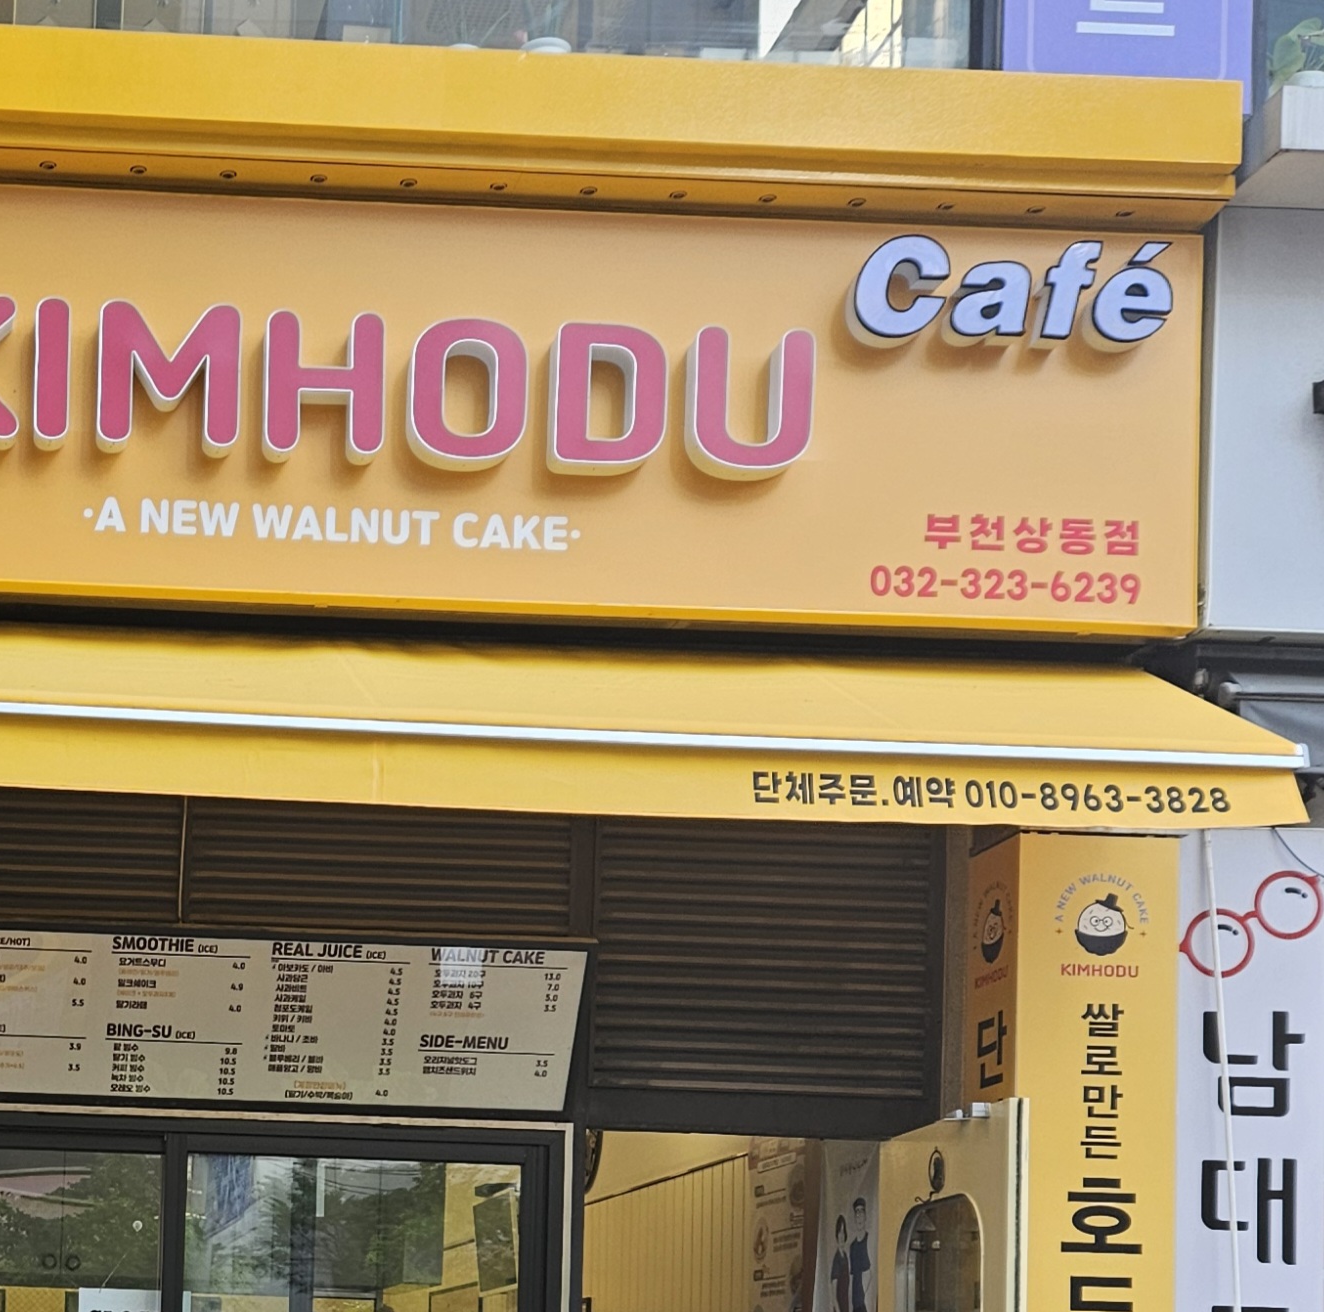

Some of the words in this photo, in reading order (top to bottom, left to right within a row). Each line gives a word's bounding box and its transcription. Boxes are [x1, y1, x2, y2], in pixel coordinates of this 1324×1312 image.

[848, 233, 1174, 350] Café
[140, 498, 240, 537] NEW
[252, 502, 441, 546] WALNUT
[924, 513, 1141, 556] 부천상동점
[870, 565, 1142, 605] 032-323-6239
[751, 770, 957, 809] 단체주문.예약
[964, 778, 1232, 813] 010-8963-3828
[1078, 873, 1133, 891] WALNUT
[1056, 883, 1077, 910] NEW
[1132, 892, 1149, 924] CAKE
[1055, 914, 1064, 922] A
[113, 936, 194, 952] SMOOTHIE
[198, 944, 218, 954] (ICE)
[272, 942, 313, 956] REAL
[317, 944, 362, 958] JUICE
[366, 951, 386, 960] (ICE)
[74, 956, 87, 964] 4.0
[119, 957, 166, 967] 요거트스무디
[431, 948, 499, 963] WALNUT
[503, 951, 545, 965] CAKE
[390, 968, 403, 976] 4.5
[1060, 963, 1139, 978] KIMHODU
[231, 983, 243, 991] 4.9
[389, 978, 401, 986] 4.5
[388, 988, 400, 996] 4.5
[546, 994, 558, 1002] 5.0
[72, 999, 84, 1007] 5.5
[387, 998, 399, 1006] 4.5
[385, 1008, 398, 1016] 4.5
[107, 1023, 172, 1038] BING-SU
[176, 1031, 196, 1040] (ICE)
[420, 1034, 508, 1049] SIDE-MENU
[375, 1089, 388, 1097] 4.0
